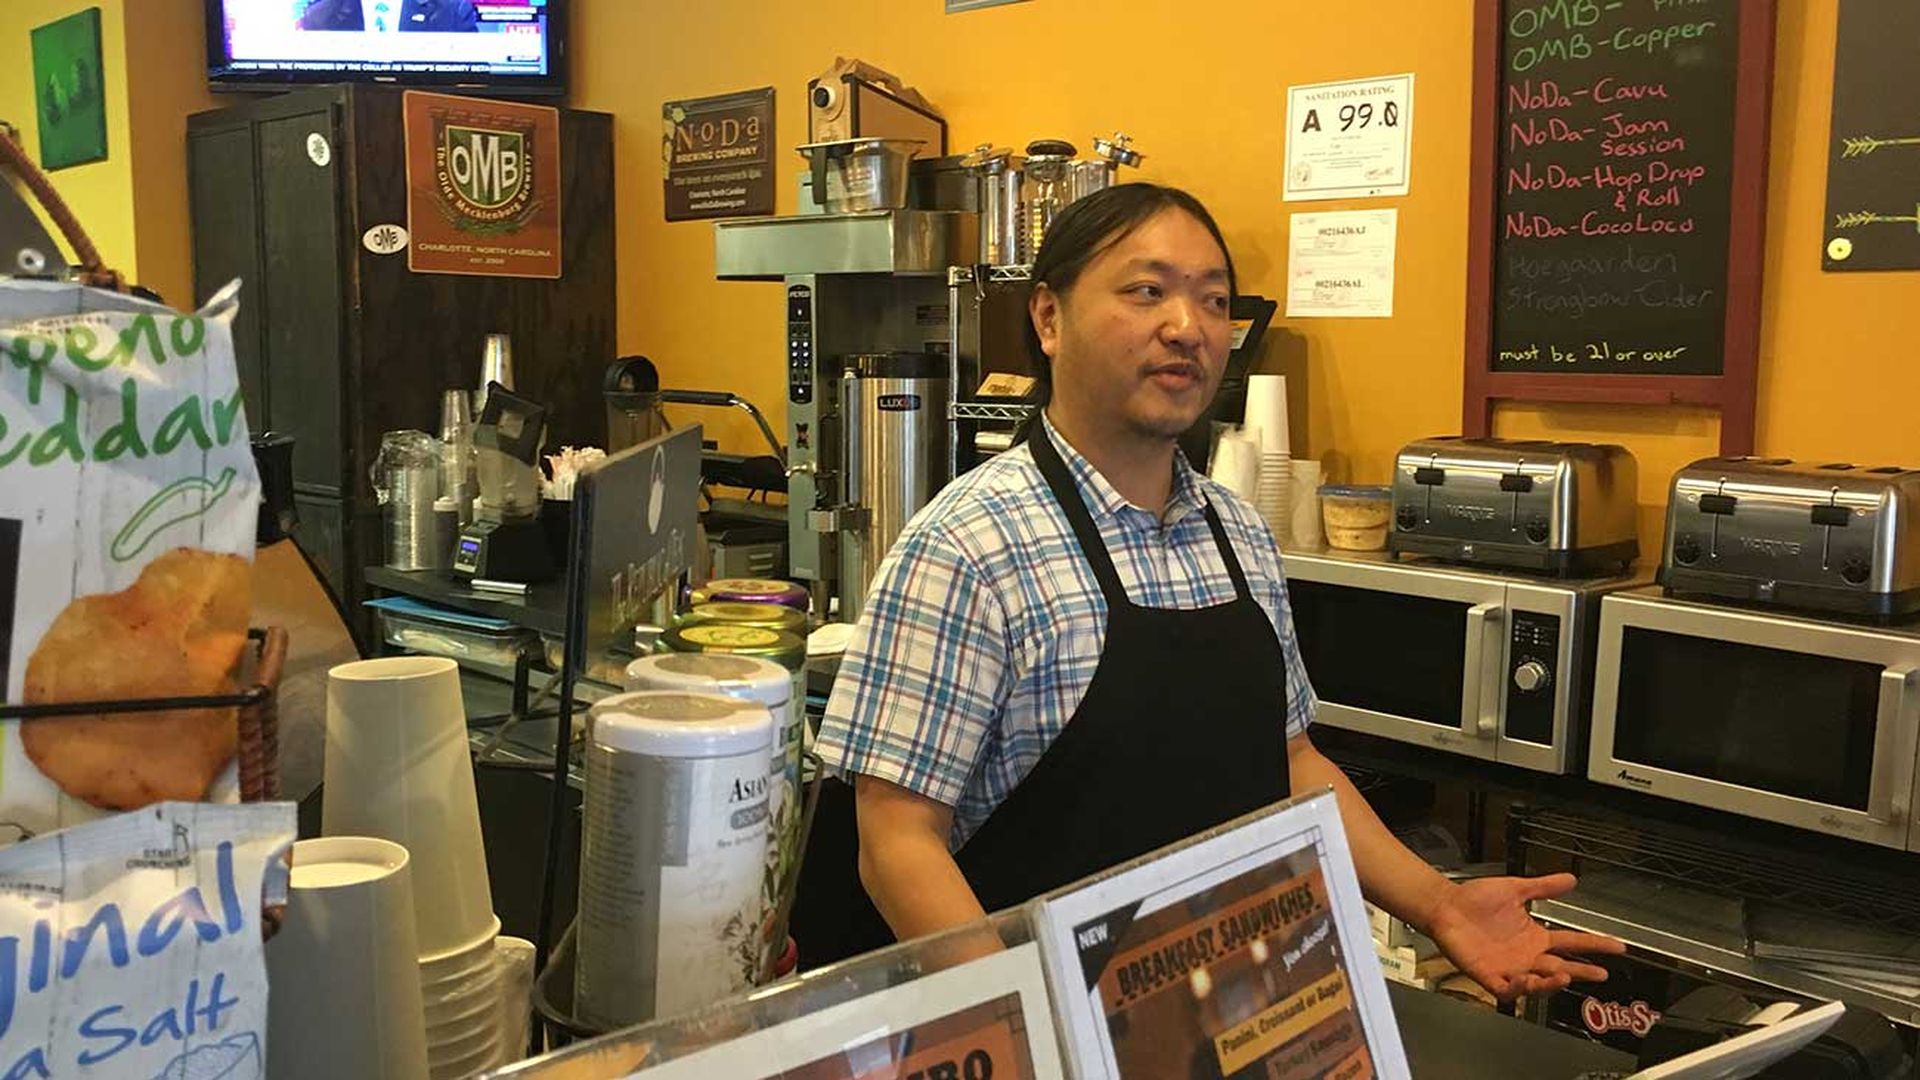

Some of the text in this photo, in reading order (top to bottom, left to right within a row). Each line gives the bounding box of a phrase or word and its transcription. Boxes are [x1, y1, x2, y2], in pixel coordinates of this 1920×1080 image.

[1305, 86, 1395, 101] SANITATION RATING
[1302, 109, 1321, 133] A
[676, 146, 758, 163] BREWING COMPANY
[452, 134, 518, 201] OMB
[1648, 161, 1706, 187] Drop
[1637, 186, 1681, 207] Roll
[455, 199, 522, 220] Mecklenburg
[373, 227, 399, 250] OMB
[476, 246, 507, 256] NORTH
[509, 247, 551, 258] CAROLINA
[1500, 341, 1688, 363] must be 21 or over
[1618, 769, 1652, 785] Amana
[1078, 922, 1108, 951] NEW
[1116, 884, 1315, 996] BREAKFAST SANDWICHES
[77, 973, 240, 1065] Salt
[1583, 1000, 1632, 1033] Otis
